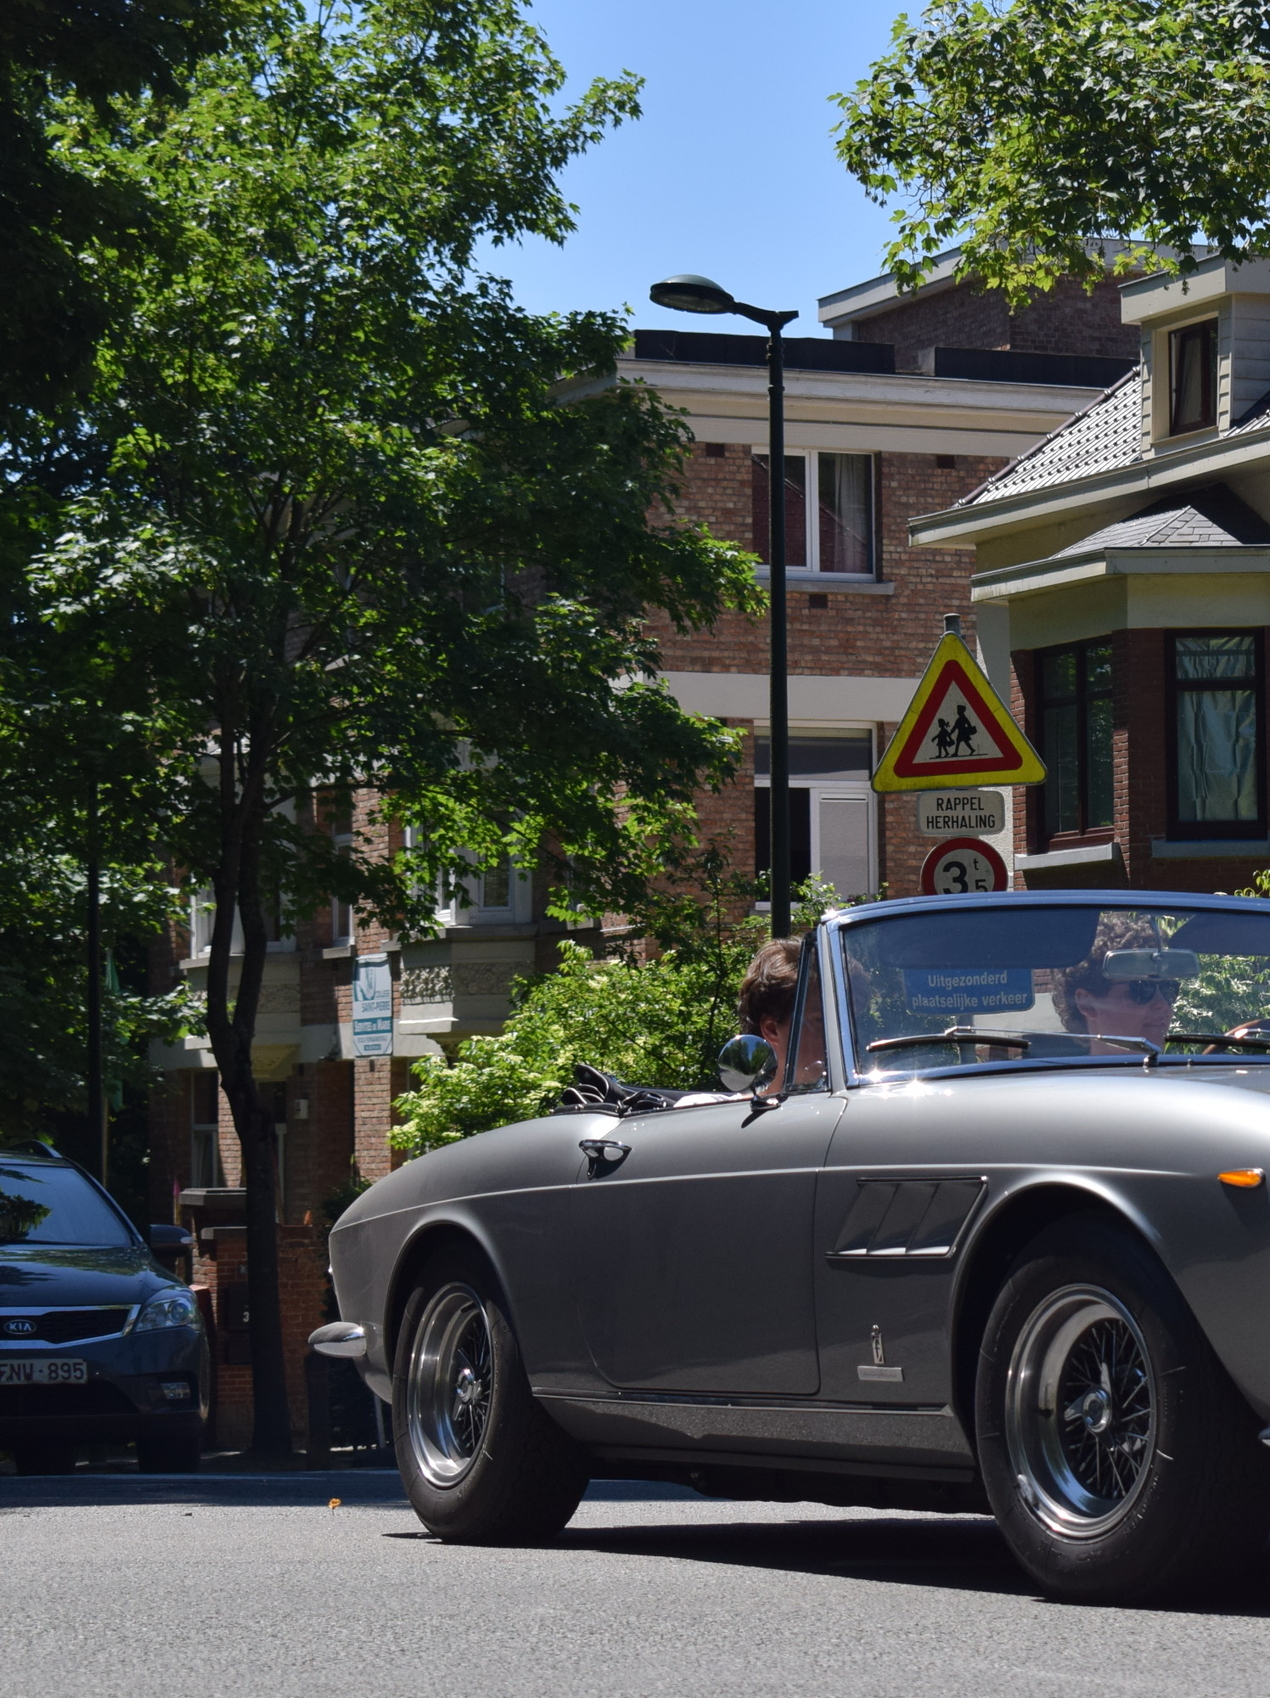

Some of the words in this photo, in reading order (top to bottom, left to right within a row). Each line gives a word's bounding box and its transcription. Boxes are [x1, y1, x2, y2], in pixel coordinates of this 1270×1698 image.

[936, 796, 985, 812] RAPPEL
[926, 814, 996, 830] HERHALING
[928, 970, 1008, 990] Uitgezonderd
[911, 993, 979, 1011] plaatselijke
[981, 991, 1028, 1007] verkeer
[9, 1322, 32, 1332] KIA
